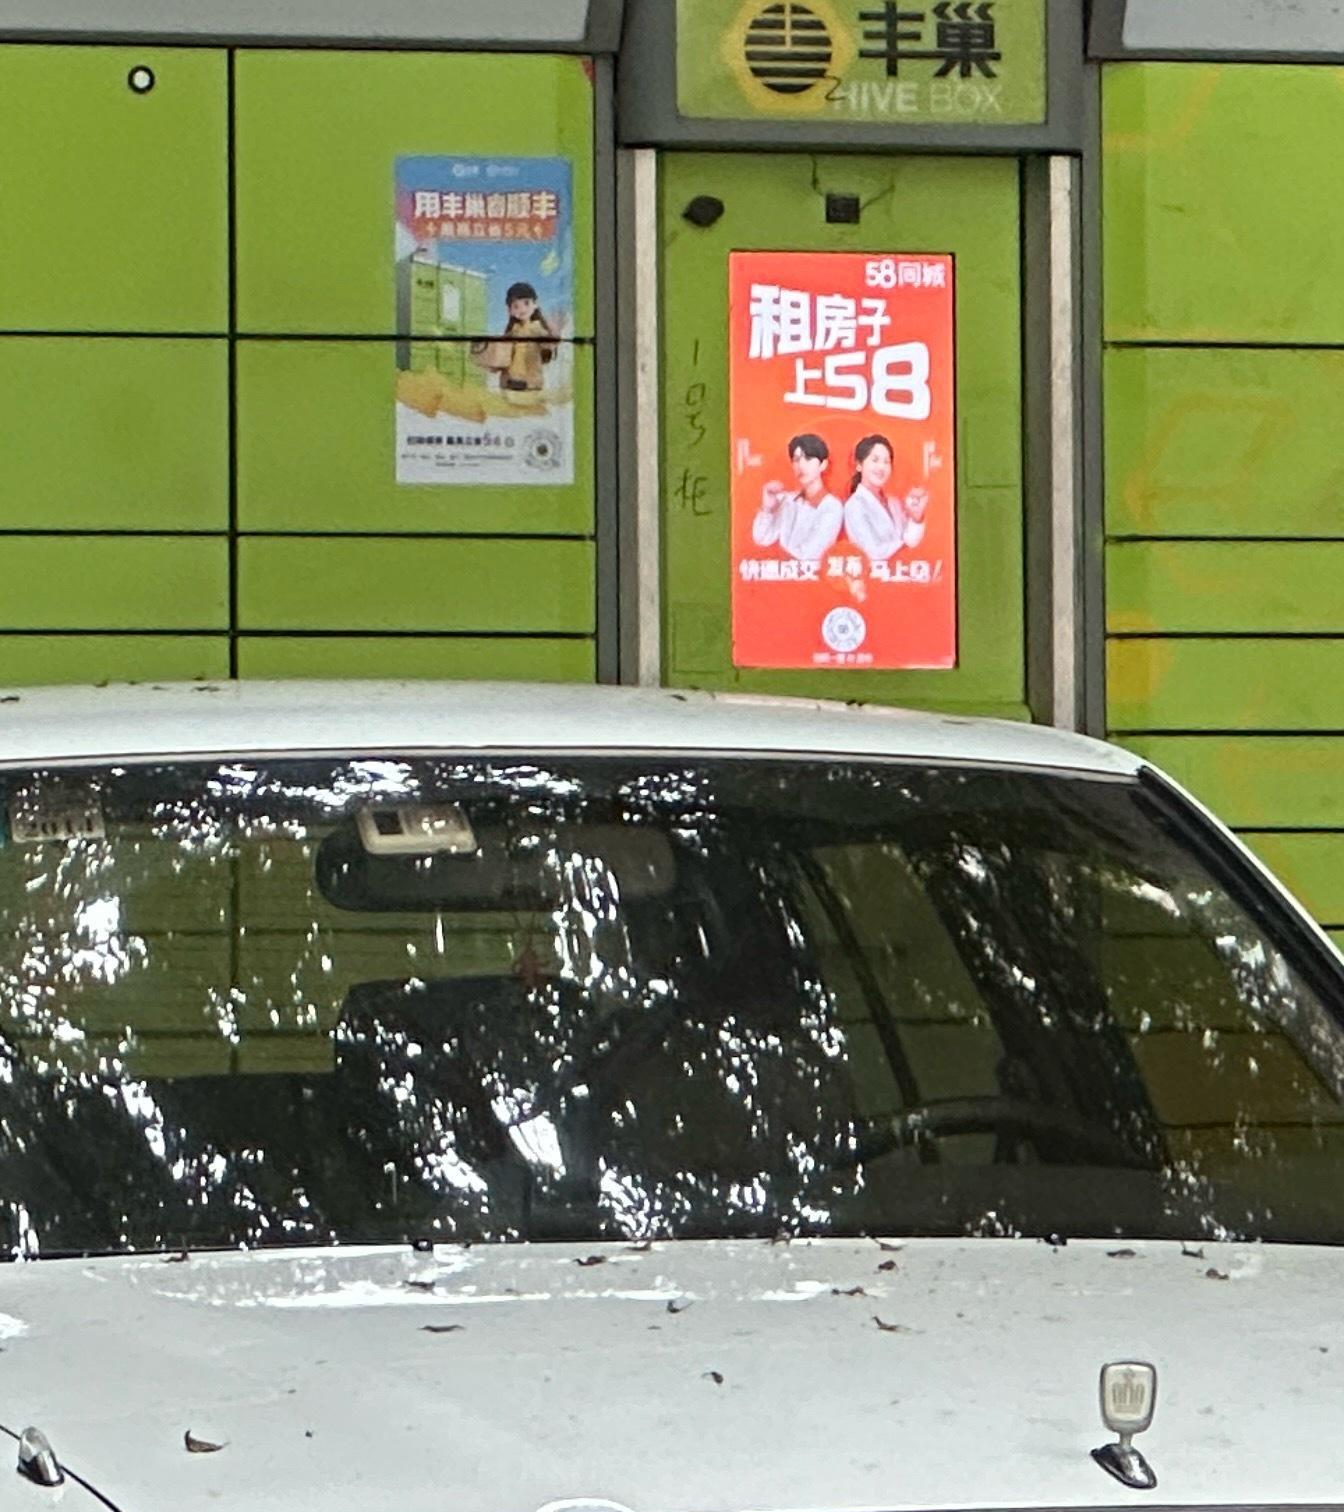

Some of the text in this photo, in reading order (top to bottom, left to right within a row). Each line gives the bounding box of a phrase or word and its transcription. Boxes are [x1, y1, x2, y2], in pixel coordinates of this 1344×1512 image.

[858, 1, 1002, 78] 丰巢
[930, 82, 1002, 113] BOX
[865, 259, 946, 288] 58同城
[748, 283, 892, 360] 租房子
[783, 341, 931, 421] 上58
